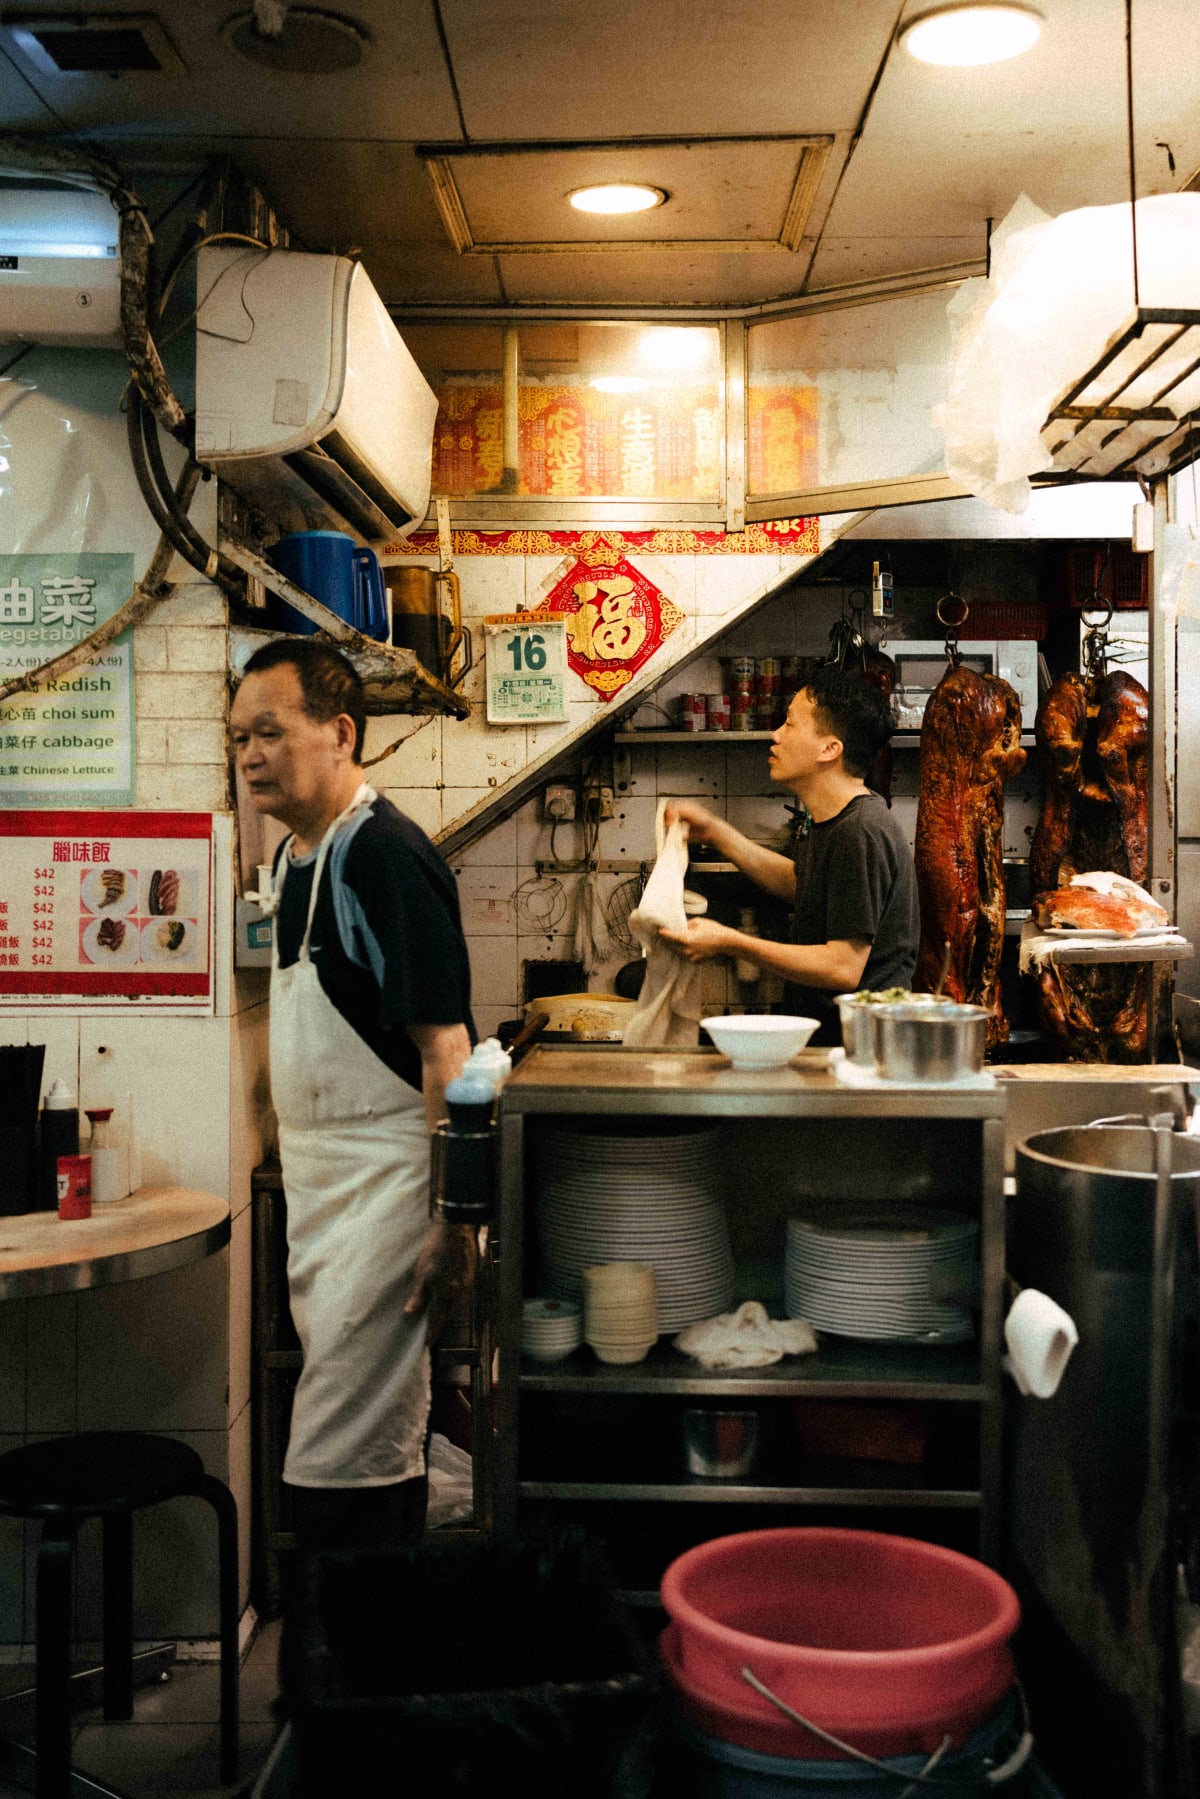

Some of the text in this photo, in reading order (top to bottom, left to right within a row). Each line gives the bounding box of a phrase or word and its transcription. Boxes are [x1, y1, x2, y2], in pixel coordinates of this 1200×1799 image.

[566, 575, 647, 661] 福
[507, 634, 547, 671] 16
[47, 677, 111, 692] Radish
[0, 707, 115, 721] 心苗 choi sum
[0, 735, 114, 749] 菜仔 cabbage
[23, 765, 69, 775] Chinese
[73, 765, 114, 775] Lettuce
[53, 842, 111, 863] 臘味飯
[34, 868, 55, 879] $42
[34, 885, 55, 896] $42
[33, 902, 54, 914] $42
[33, 919, 54, 931] $42
[32, 937, 53, 948] $42
[32, 954, 53, 966] $42
